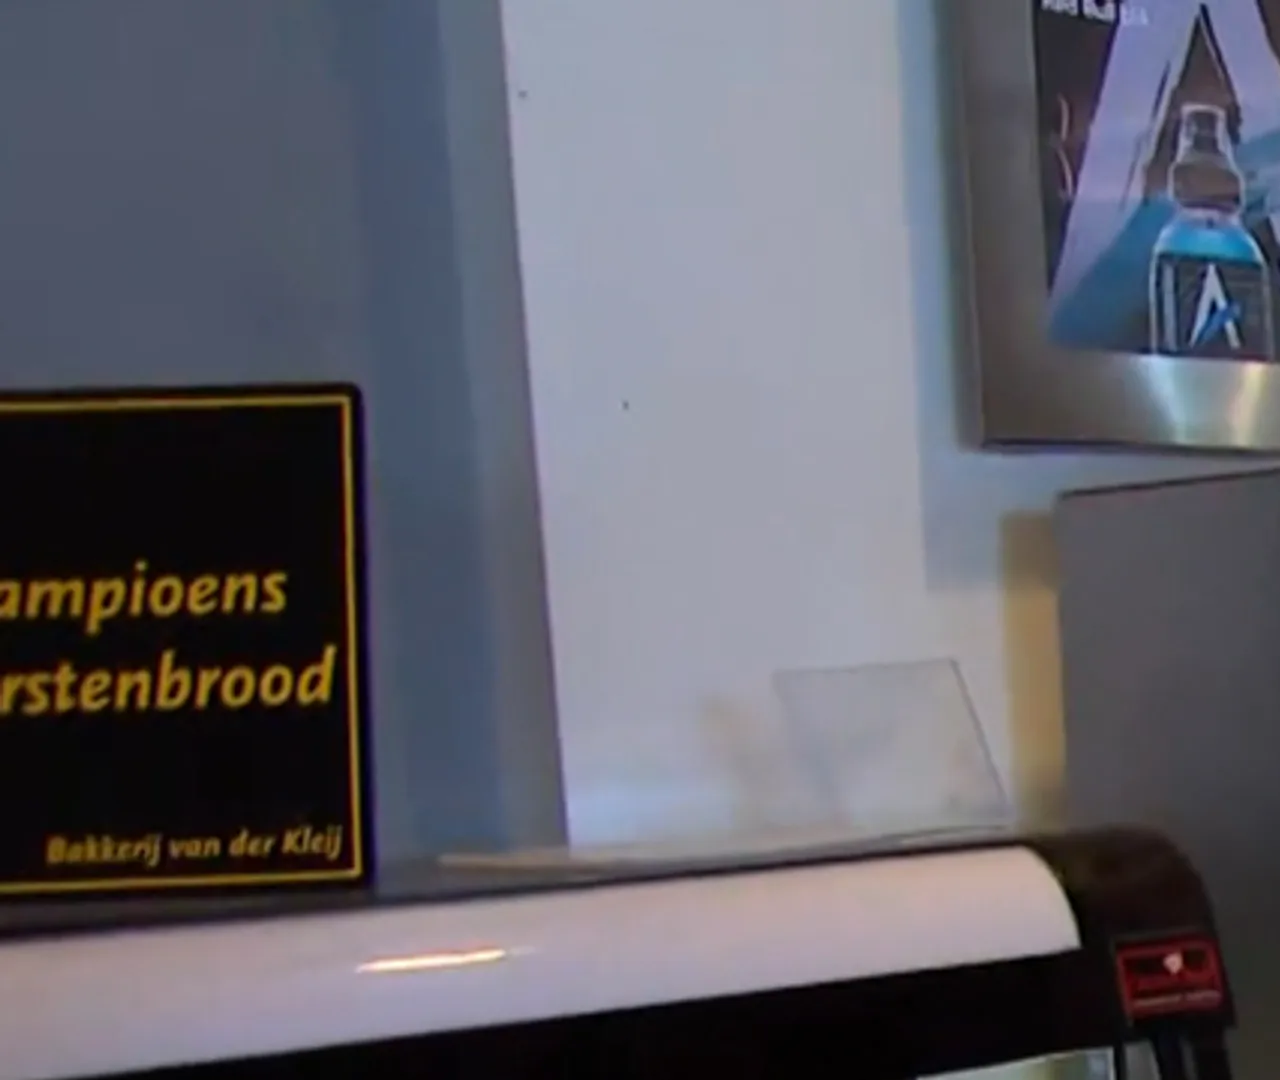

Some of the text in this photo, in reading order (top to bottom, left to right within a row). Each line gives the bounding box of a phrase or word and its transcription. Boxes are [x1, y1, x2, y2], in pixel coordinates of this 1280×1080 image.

[0, 558, 288, 636] ampioens
[0, 643, 337, 717] rstenbrood
[46, 824, 343, 868] Bakkerij van der Kleij
